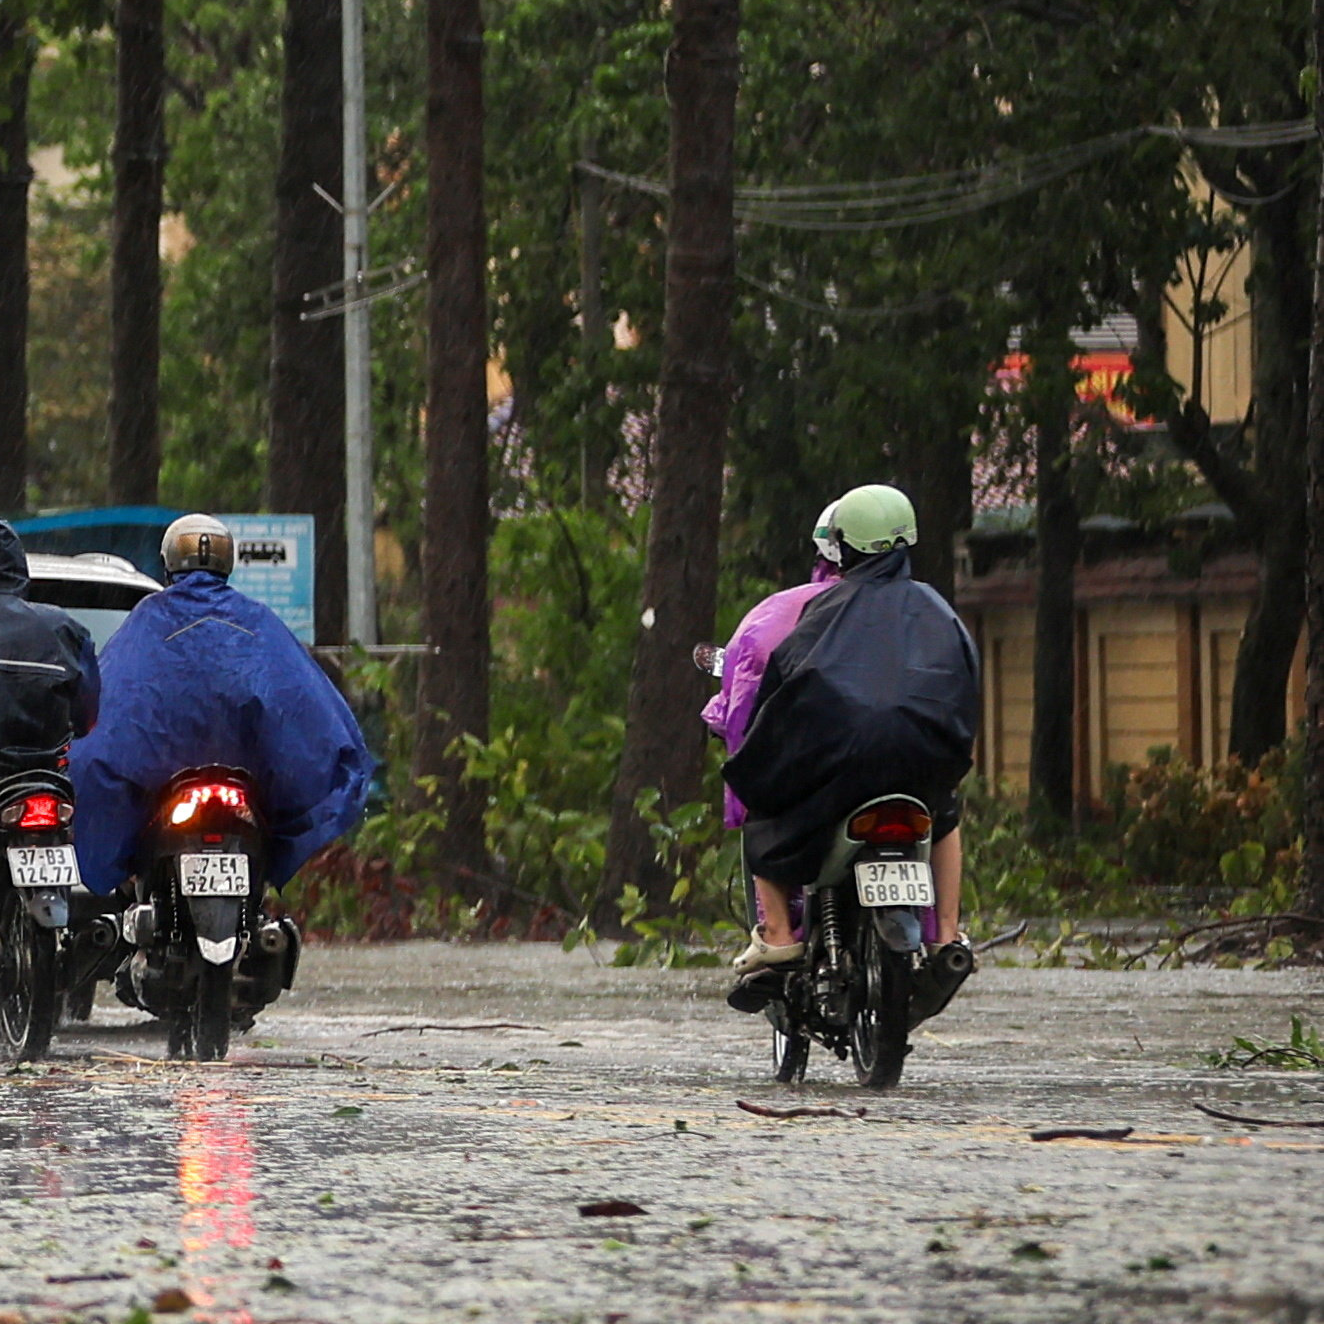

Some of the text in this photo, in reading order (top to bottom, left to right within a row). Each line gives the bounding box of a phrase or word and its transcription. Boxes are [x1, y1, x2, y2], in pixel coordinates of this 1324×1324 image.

[17, 849, 66, 865] 37-B3
[17, 866, 73, 884] 124.77
[867, 864, 919, 882] 37-N1
[864, 883, 929, 903] 688.05
